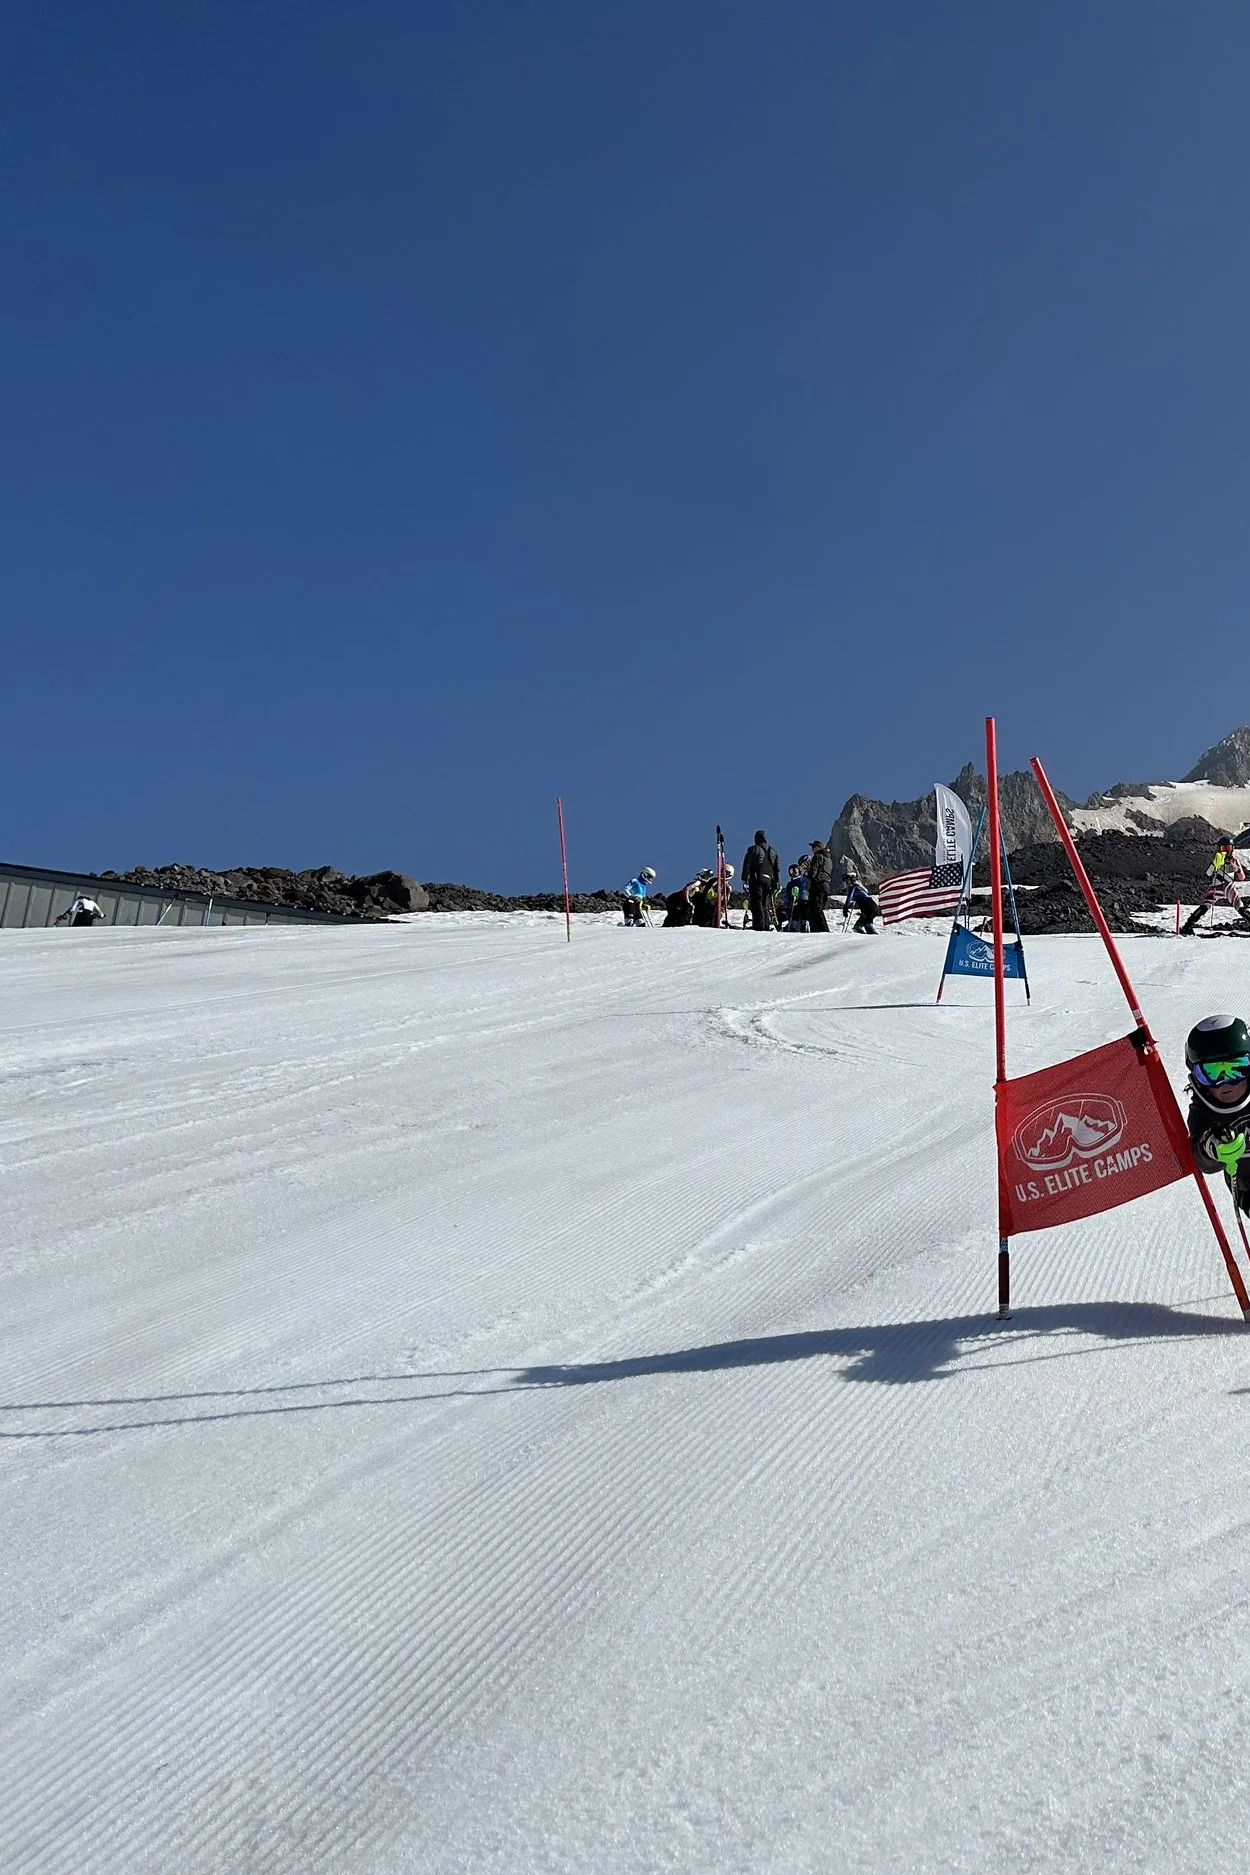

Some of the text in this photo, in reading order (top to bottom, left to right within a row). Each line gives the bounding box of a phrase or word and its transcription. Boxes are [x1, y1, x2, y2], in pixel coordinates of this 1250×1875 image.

[958, 959, 970, 967] U.S.
[971, 962, 988, 970] ELITE
[1015, 1143, 1153, 1202] U.S. ELITE CAMPS
